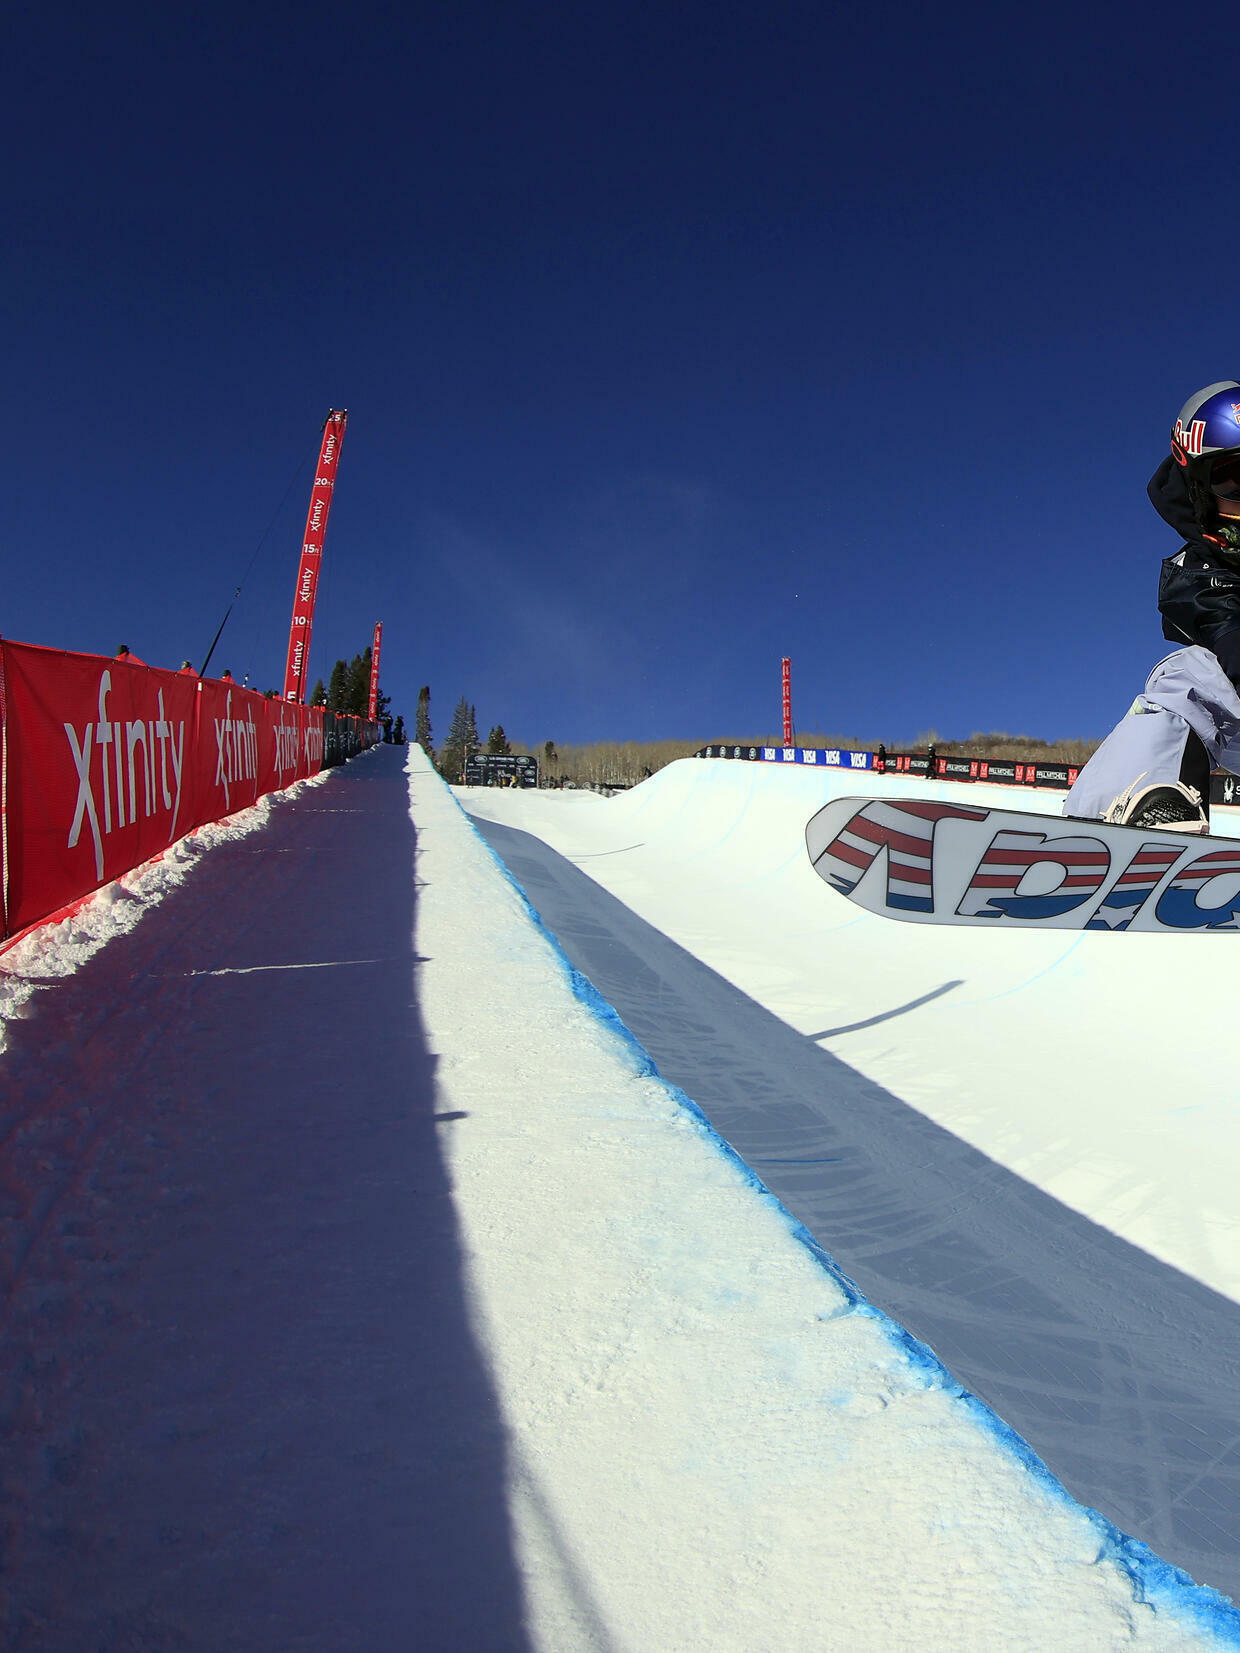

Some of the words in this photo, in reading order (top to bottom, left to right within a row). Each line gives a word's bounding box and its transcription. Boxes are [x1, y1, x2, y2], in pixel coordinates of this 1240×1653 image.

[323, 434, 337, 464] xfinity
[1175, 419, 1206, 455] Bull
[310, 499, 325, 532] xfinity
[299, 567, 314, 602] xfinity
[291, 640, 304, 677] xfinity
[764, 748, 775, 760] VISA
[783, 748, 795, 761] VISA
[803, 749, 816, 764] VISA
[825, 750, 840, 764] VISA
[850, 752, 867, 768] VISA
[64, 669, 184, 882] xfinity
